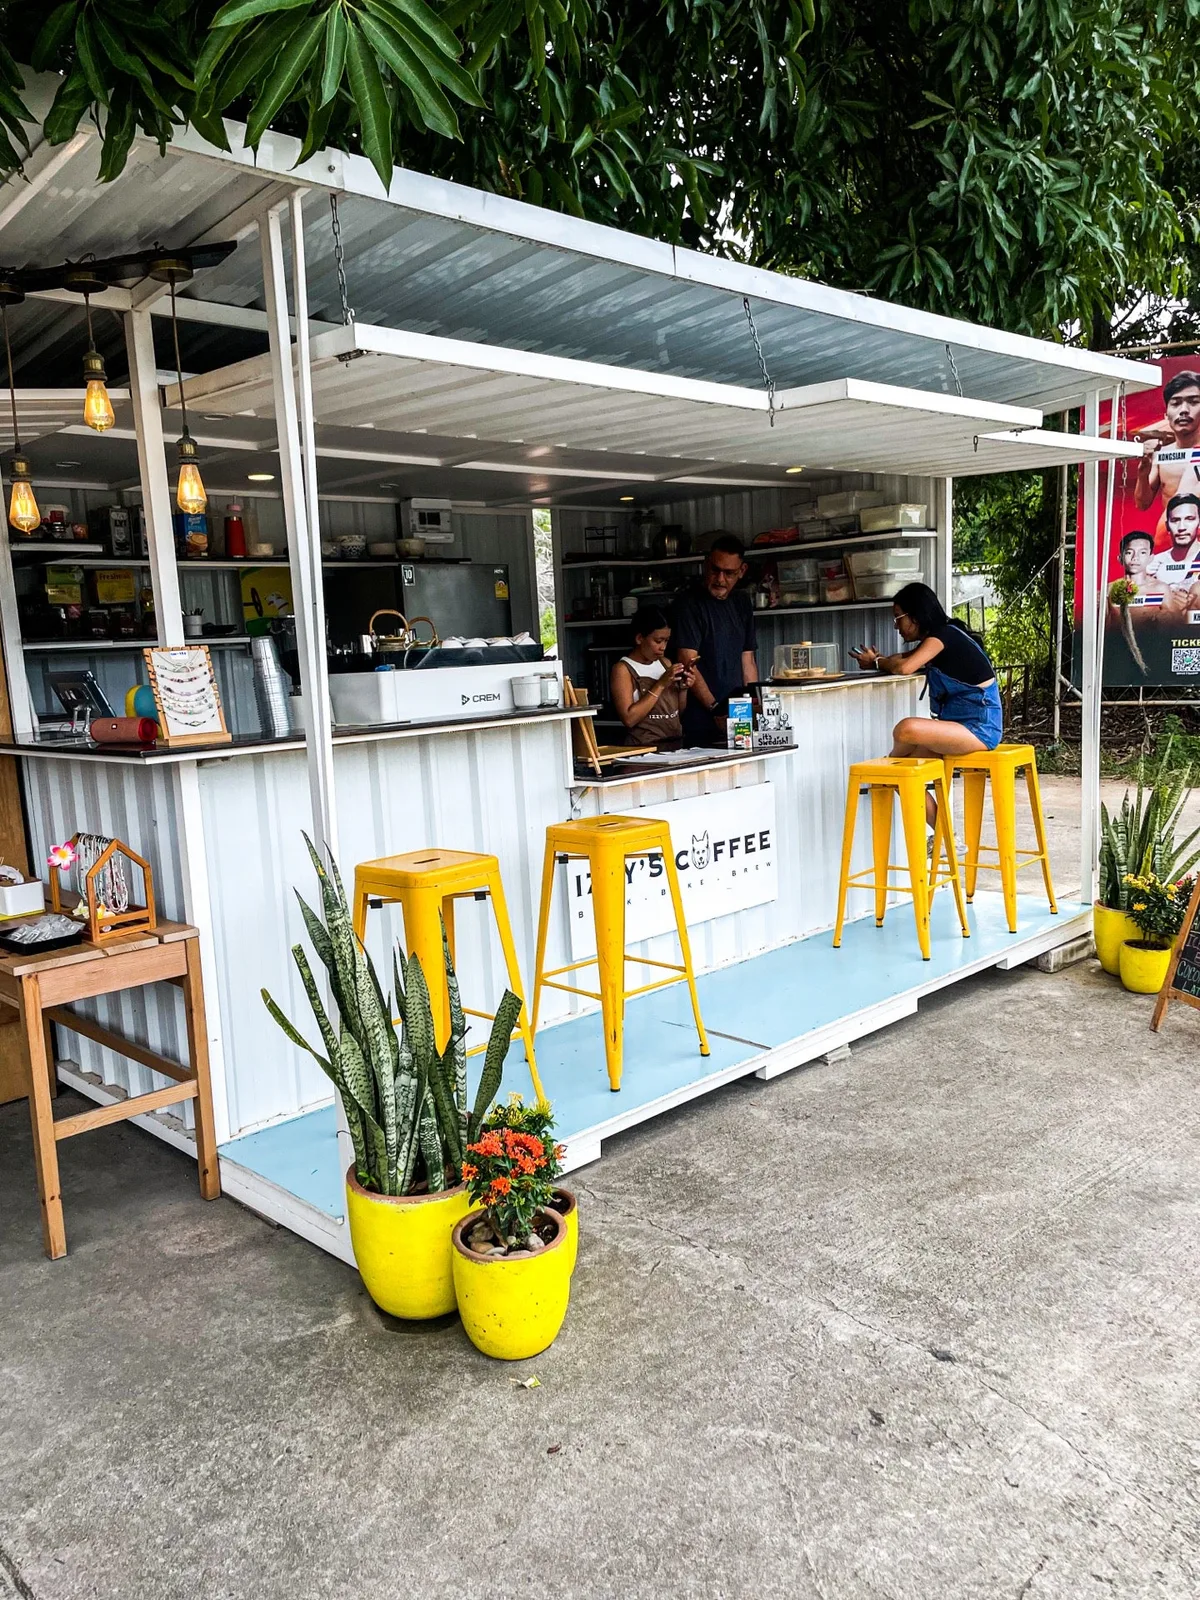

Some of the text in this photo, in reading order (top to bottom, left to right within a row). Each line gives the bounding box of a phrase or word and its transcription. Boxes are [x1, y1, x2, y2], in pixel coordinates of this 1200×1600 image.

[1158, 452, 1186, 461] KONGSIAM
[404, 569, 413, 580] 10
[472, 693, 501, 703] CREM
[758, 736, 789, 746] Swedish!
[575, 856, 664, 898] IY'S
[578, 861, 772, 919] BK BKE BREW
